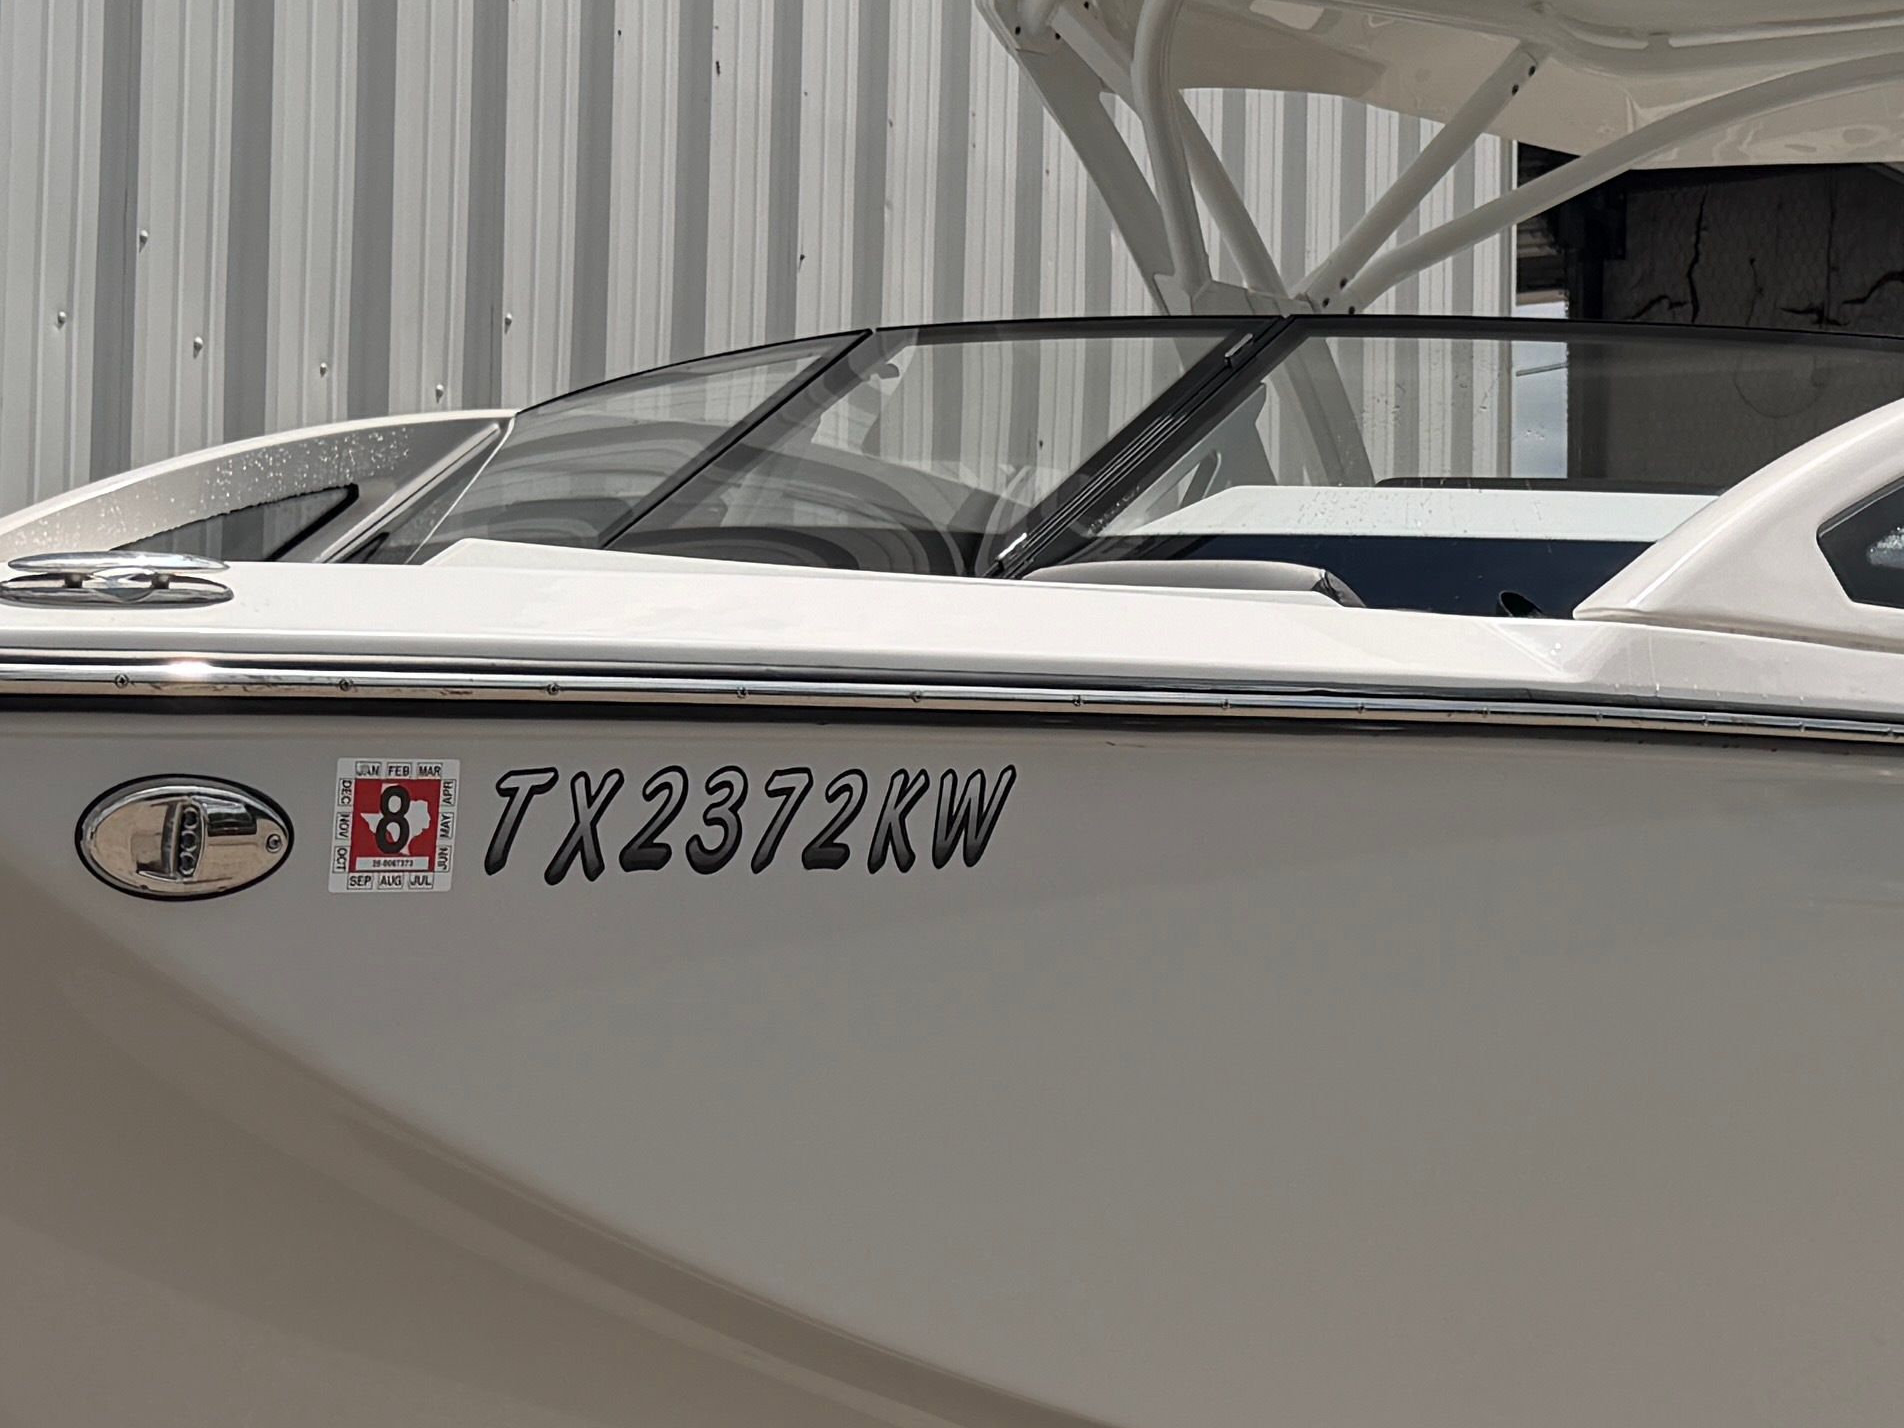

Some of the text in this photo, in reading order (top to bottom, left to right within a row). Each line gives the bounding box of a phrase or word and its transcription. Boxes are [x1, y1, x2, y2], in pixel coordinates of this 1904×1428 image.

[388, 765, 410, 777] FEB
[418, 765, 442, 777] MAR
[341, 779, 353, 806] DEC
[442, 781, 454, 805] APR
[339, 813, 350, 838] NOV
[376, 785, 411, 854] 8
[440, 814, 452, 838] MAY
[484, 765, 1017, 886] TX2372KW
[336, 847, 348, 870] OCT
[437, 847, 449, 870] JUN
[349, 875, 433, 887] SEP AUG JUL
